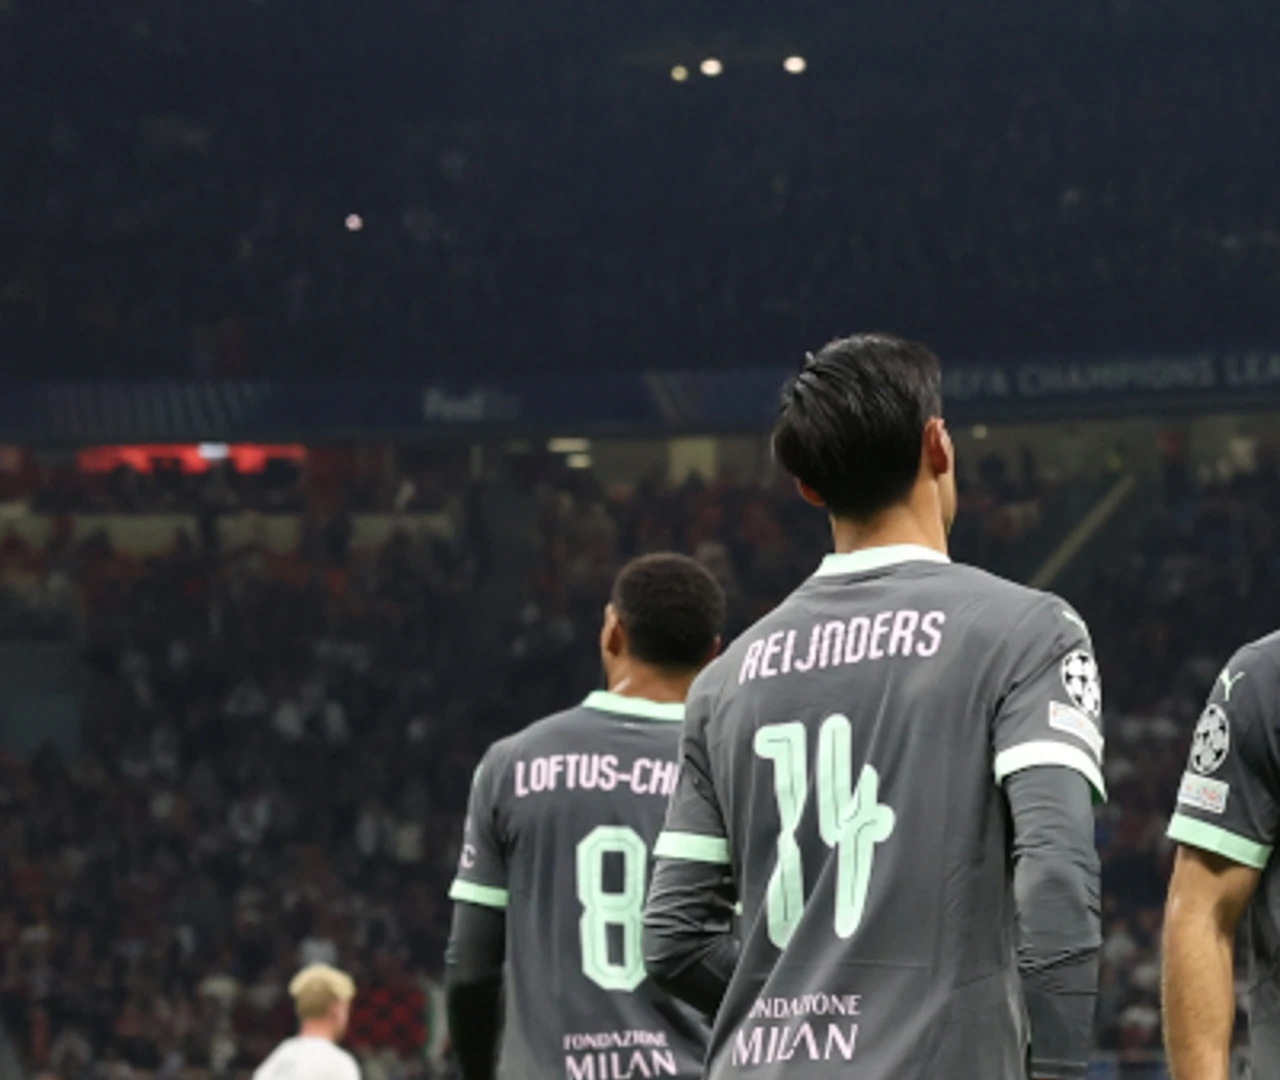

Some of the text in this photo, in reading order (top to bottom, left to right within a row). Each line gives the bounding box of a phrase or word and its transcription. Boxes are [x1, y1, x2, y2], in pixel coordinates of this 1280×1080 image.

[738, 610, 946, 686] REIJNDERS
[514, 753, 680, 797] LOFTUS-CH
[753, 713, 896, 950] 14
[576, 825, 648, 993] 8
[563, 1030, 668, 1051] FONDAZIONE
[732, 1022, 859, 1067] MILAN
